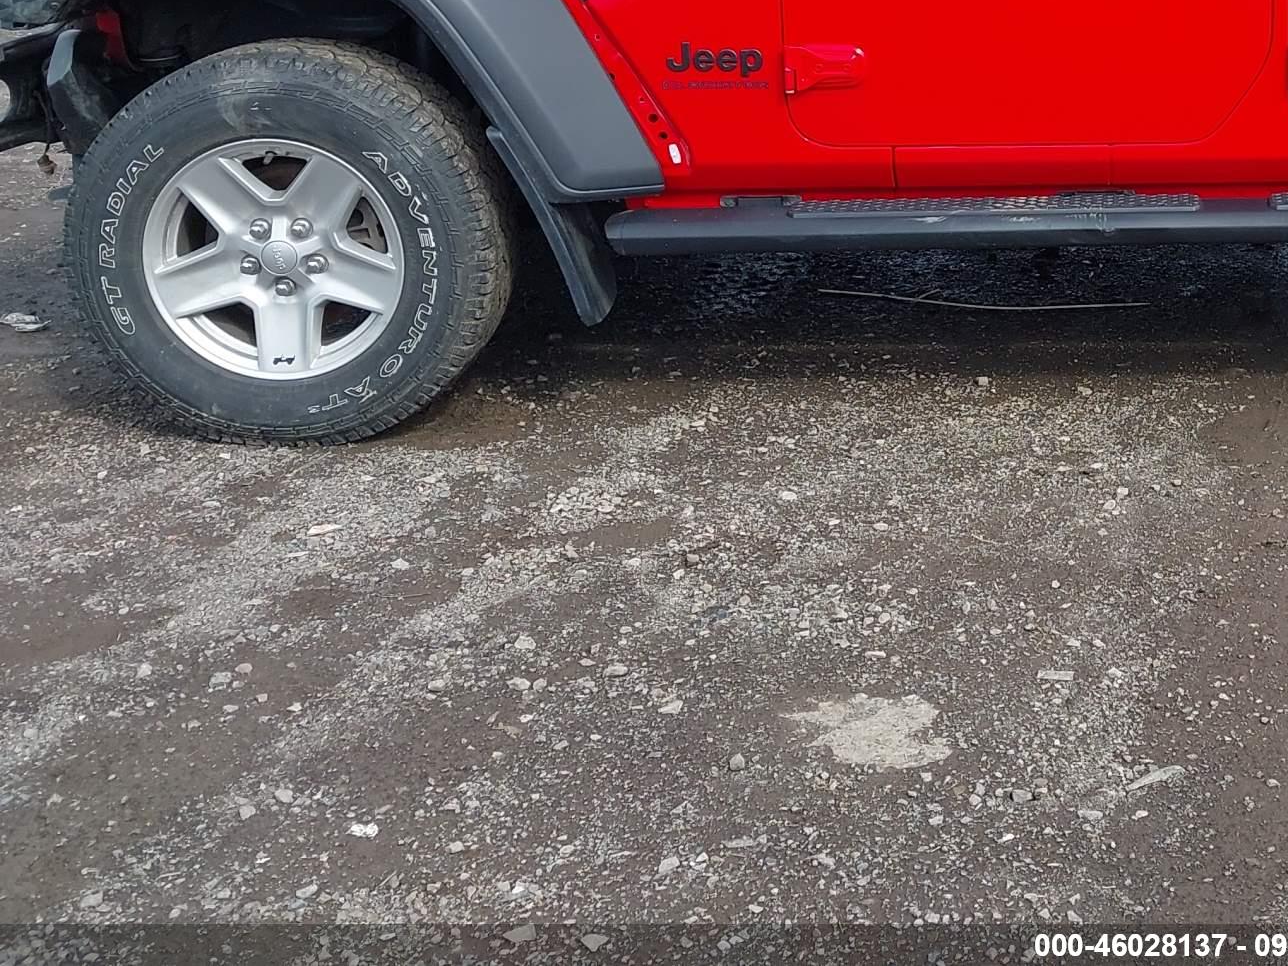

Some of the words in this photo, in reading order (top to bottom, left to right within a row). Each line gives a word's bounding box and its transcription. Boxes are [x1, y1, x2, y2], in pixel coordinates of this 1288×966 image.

[666, 41, 763, 78] Jeep
[99, 144, 165, 268] RADIAL
[101, 276, 136, 335] GT
[361, 151, 438, 378] ADVENTURO
